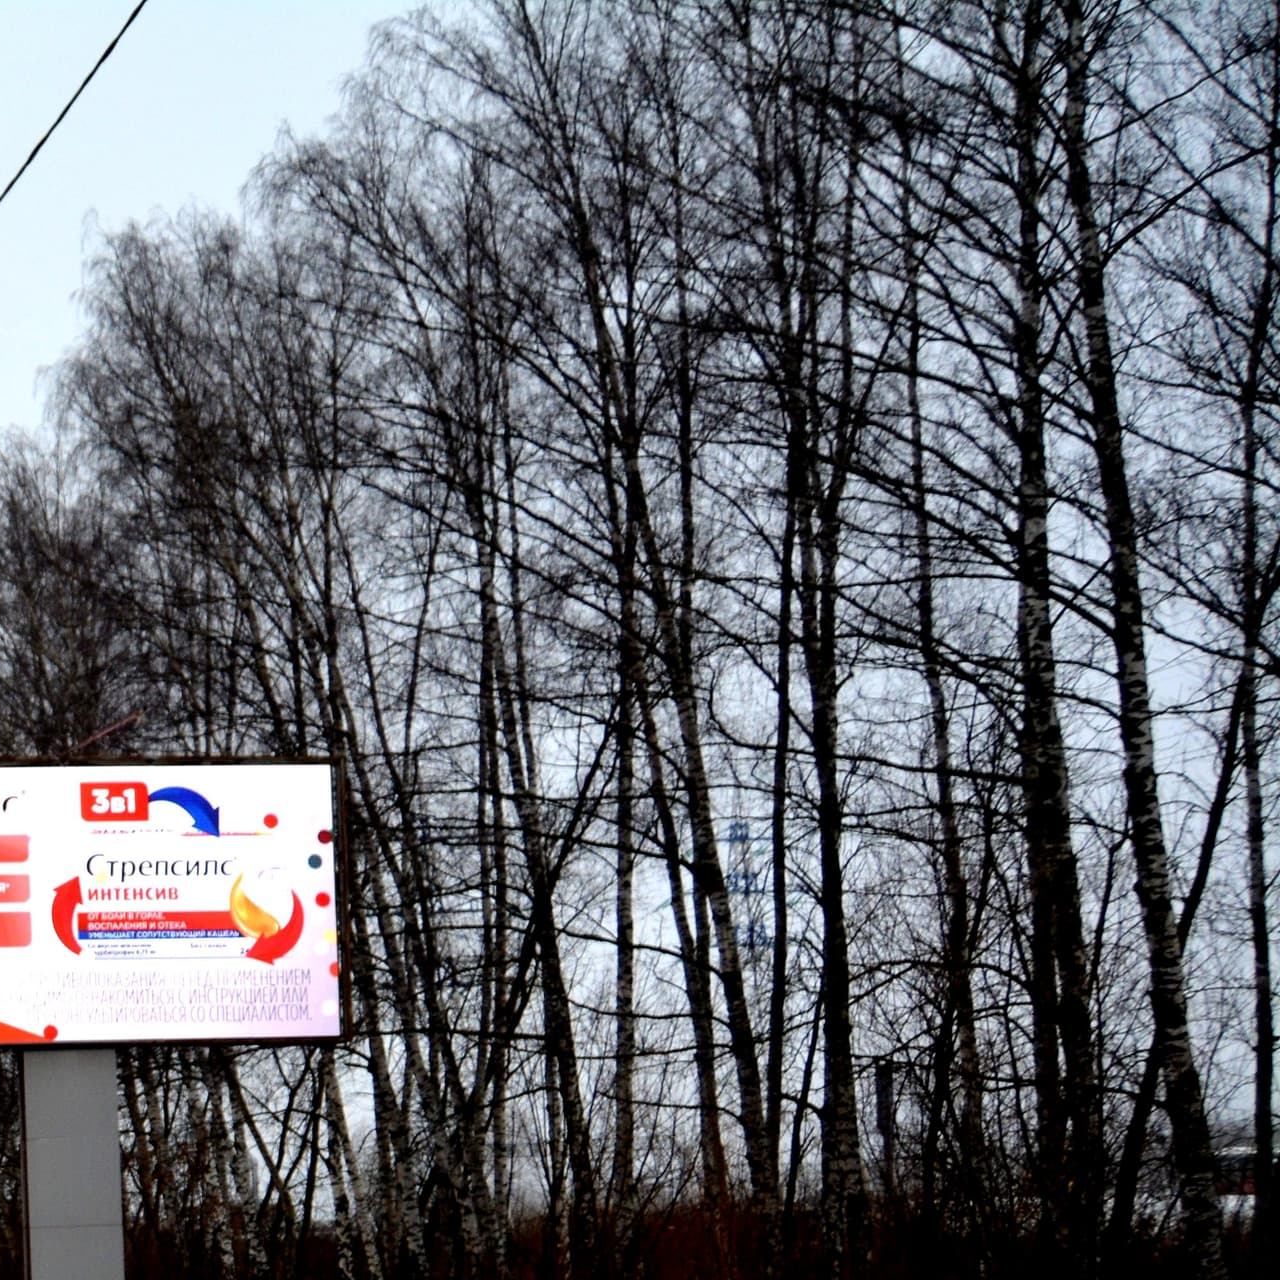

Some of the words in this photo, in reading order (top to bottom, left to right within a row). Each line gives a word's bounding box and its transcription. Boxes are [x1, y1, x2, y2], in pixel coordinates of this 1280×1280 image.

[91, 788, 136, 814] 3в1
[86, 854, 233, 882] Стрепсилс
[88, 887, 179, 901] ИНТЕНСИВ
[88, 922, 148, 930] ВОСПАЛЕНИЯ
[157, 921, 187, 930] ОТЕКА
[189, 986, 278, 1005] ИНСТРУКЦИЕЙ
[281, 986, 309, 1003] ИЛИ
[190, 1005, 206, 1022] СО
